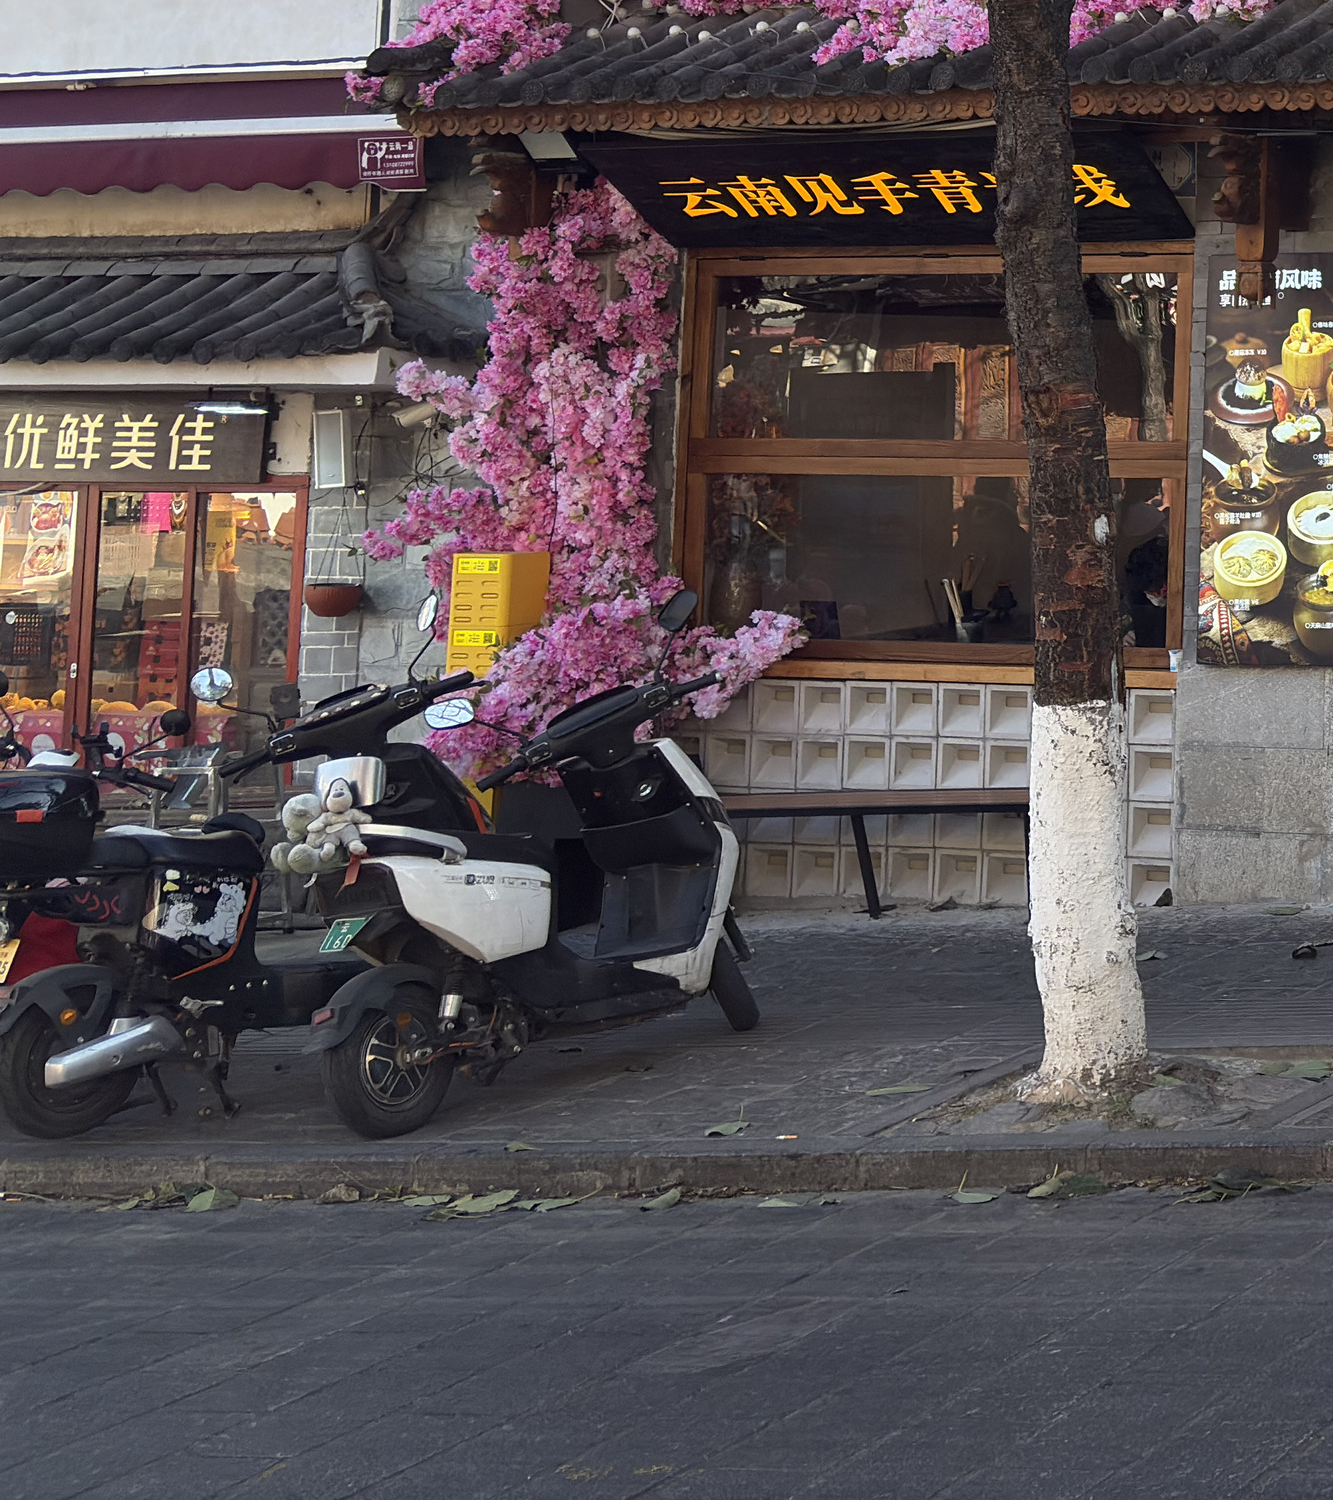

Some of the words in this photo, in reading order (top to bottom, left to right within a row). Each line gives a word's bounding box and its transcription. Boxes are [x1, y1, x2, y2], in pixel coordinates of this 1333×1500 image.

[658, 164, 1131, 218] 云南见手青线
[1219, 268, 1322, 291] 品风味
[4, 413, 215, 470] 优鲜美佳
